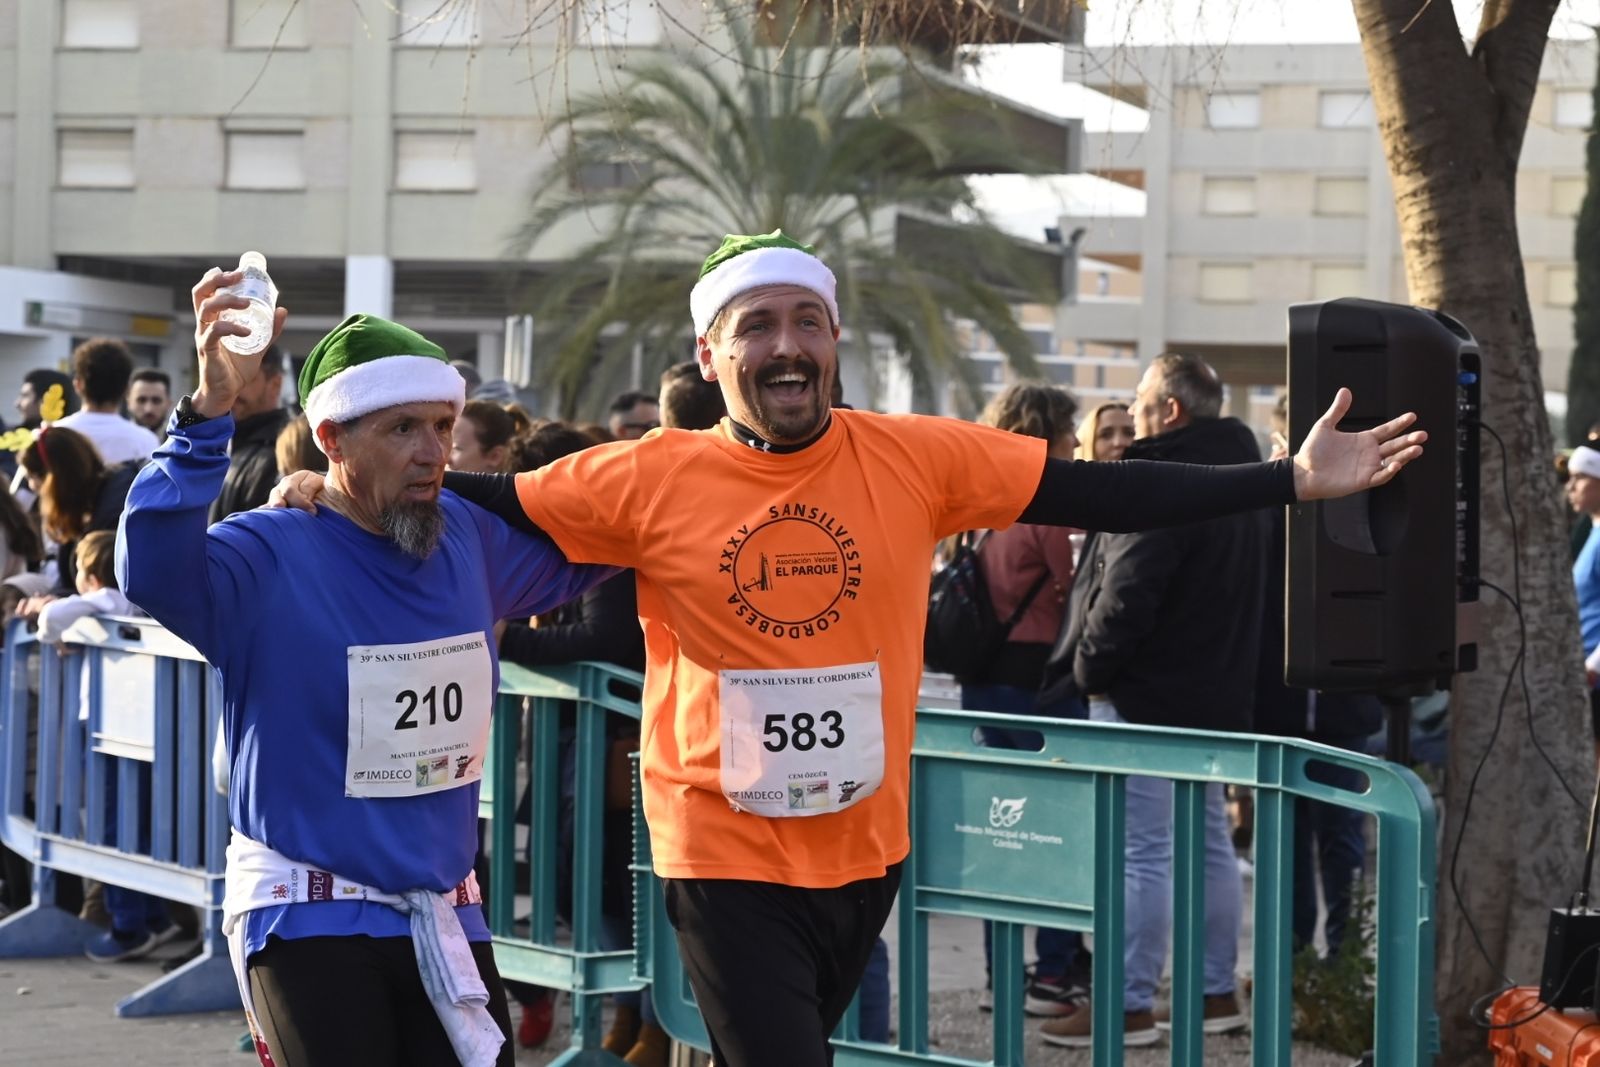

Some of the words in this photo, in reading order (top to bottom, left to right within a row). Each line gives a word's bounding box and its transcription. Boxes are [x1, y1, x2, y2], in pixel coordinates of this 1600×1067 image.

[719, 525, 749, 573] XXXV
[769, 503, 861, 600] SANSILVESTRE
[776, 567, 789, 577] EL
[792, 564, 838, 576] PARQUE
[727, 593, 840, 639] CORDOBESA
[375, 654, 395, 662] SAN
[397, 649, 441, 661] SILVESTRE
[441, 641, 483, 655] CORDOBESA
[742, 678, 761, 686] SAN
[762, 676, 815, 686] SILVESTRE
[817, 671, 873, 684] CORDOBESA
[394, 682, 463, 730] 210
[763, 710, 845, 753] 583
[390, 751, 417, 760] MANUEL
[367, 769, 412, 780] IMDECO
[741, 791, 783, 800] IMDECO
